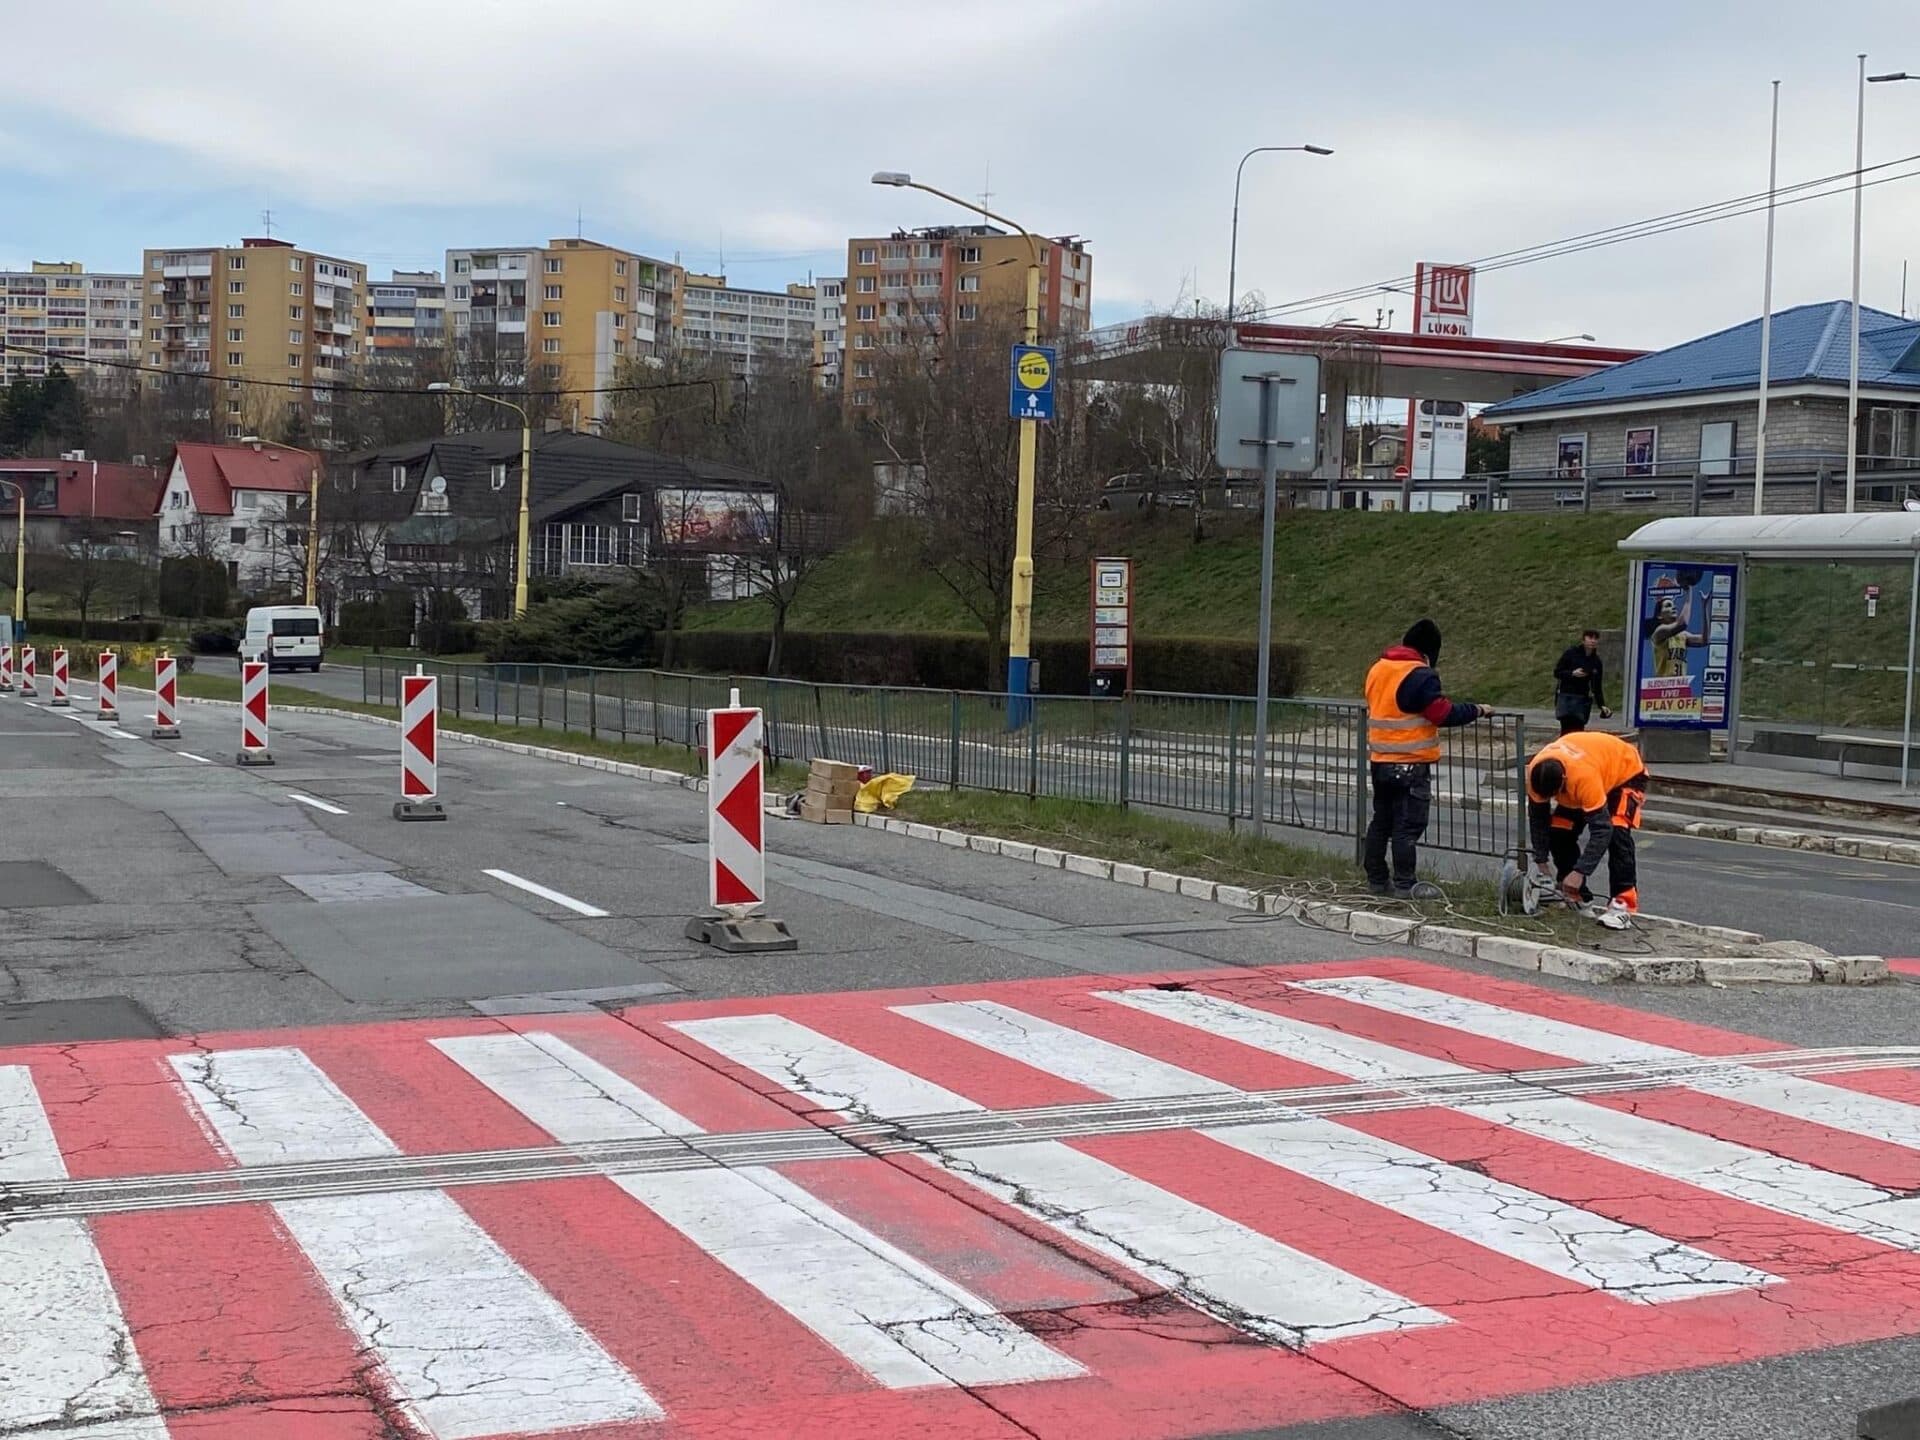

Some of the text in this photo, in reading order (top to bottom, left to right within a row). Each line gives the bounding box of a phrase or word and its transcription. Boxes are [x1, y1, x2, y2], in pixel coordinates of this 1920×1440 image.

[1428, 322, 1467, 336] LUKOIL
[1645, 700, 1673, 711] PLAY
[1677, 699, 1697, 710] OFF
